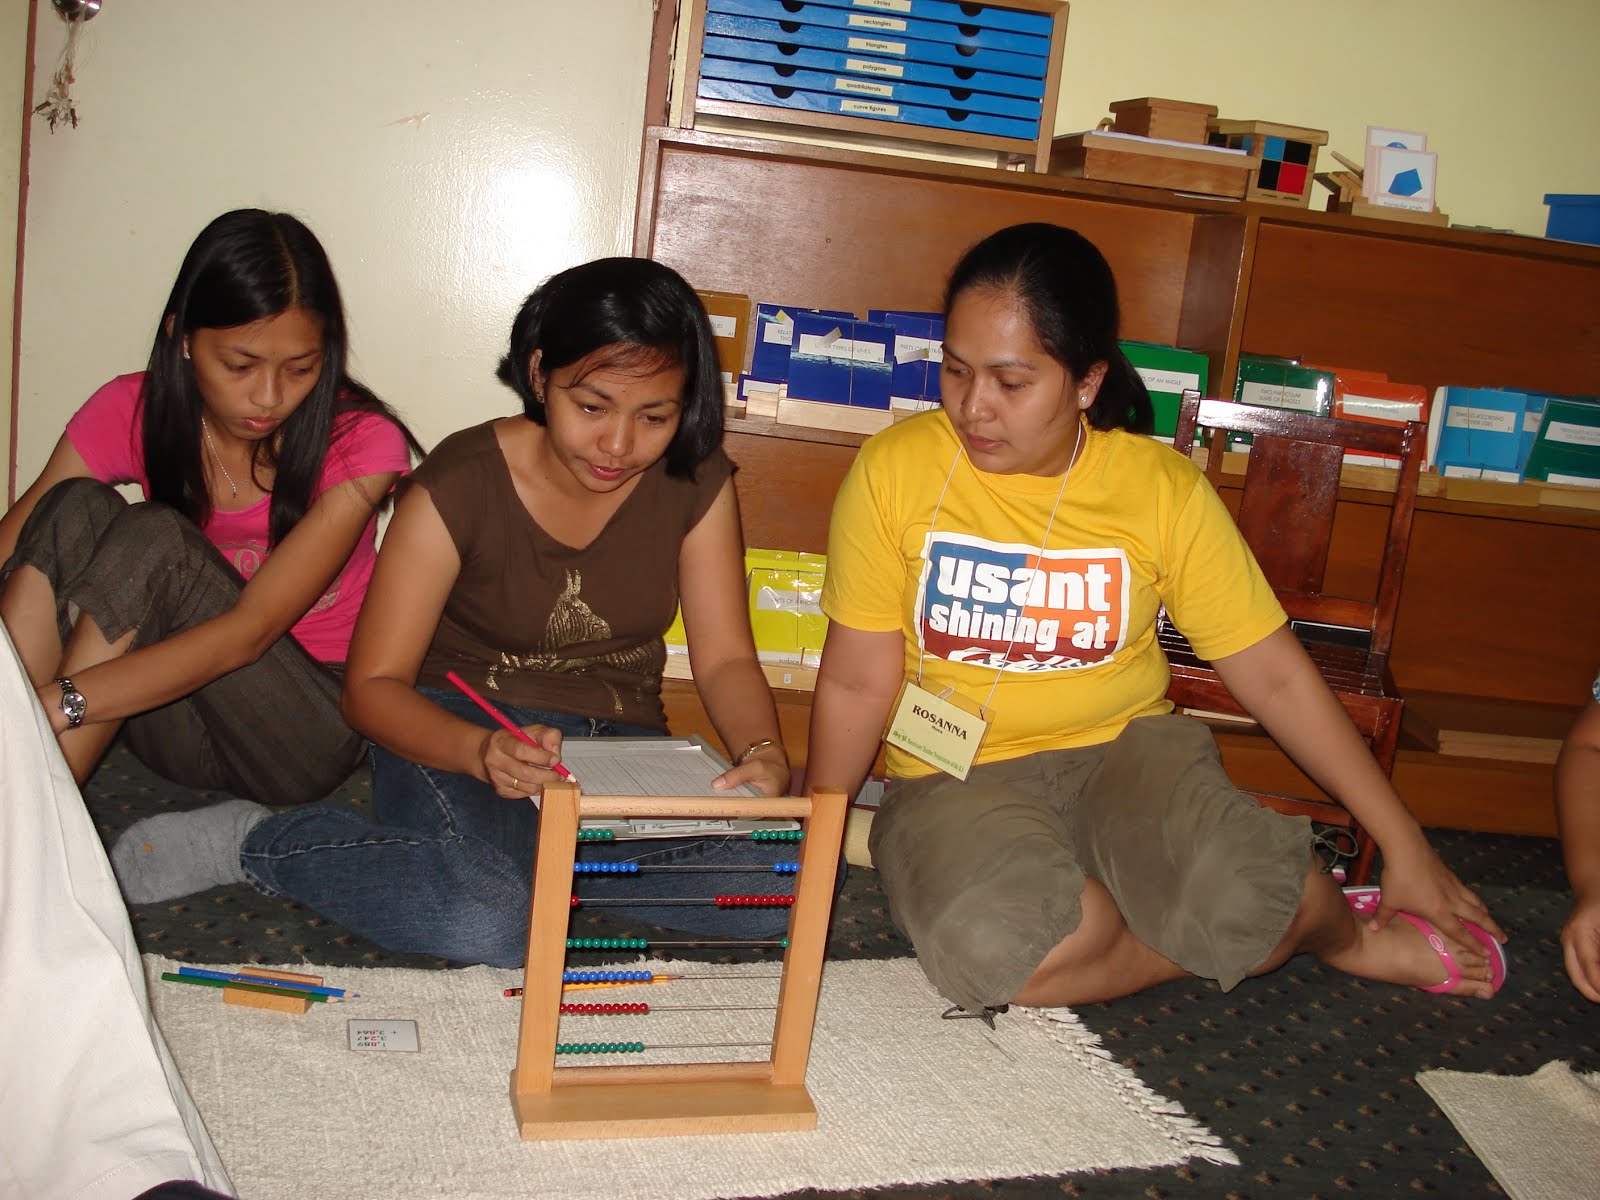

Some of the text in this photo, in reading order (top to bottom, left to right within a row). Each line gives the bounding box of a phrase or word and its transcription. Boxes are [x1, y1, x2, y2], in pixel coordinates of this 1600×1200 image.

[863, 18, 892, 27] rectangles
[865, 41, 888, 49] triangles
[862, 63, 887, 72] polygons
[869, 104, 887, 112] figures
[937, 556, 1111, 612] usant
[929, 601, 1110, 652] shining at
[912, 704, 967, 741] ROSANNA
